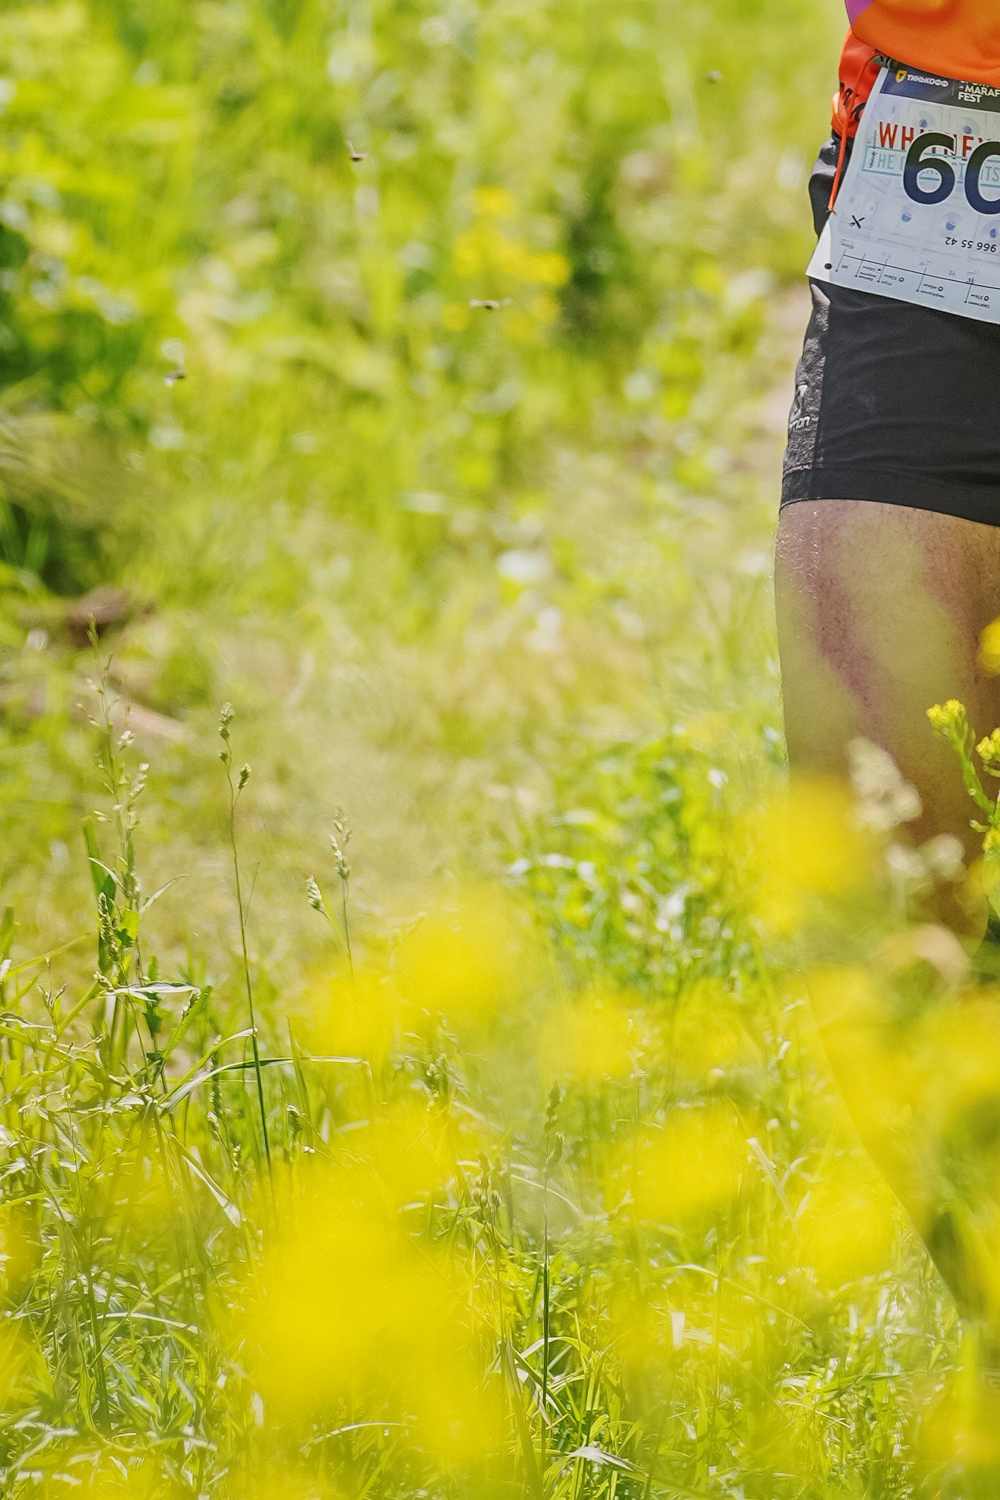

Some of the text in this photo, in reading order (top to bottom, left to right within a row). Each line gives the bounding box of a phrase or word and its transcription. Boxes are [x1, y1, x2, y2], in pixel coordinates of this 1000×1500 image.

[957, 92, 982, 104] FEST
[944, 236, 958, 246] 42
[960, 239, 974, 249] 55
[976, 241, 997, 253] 966
